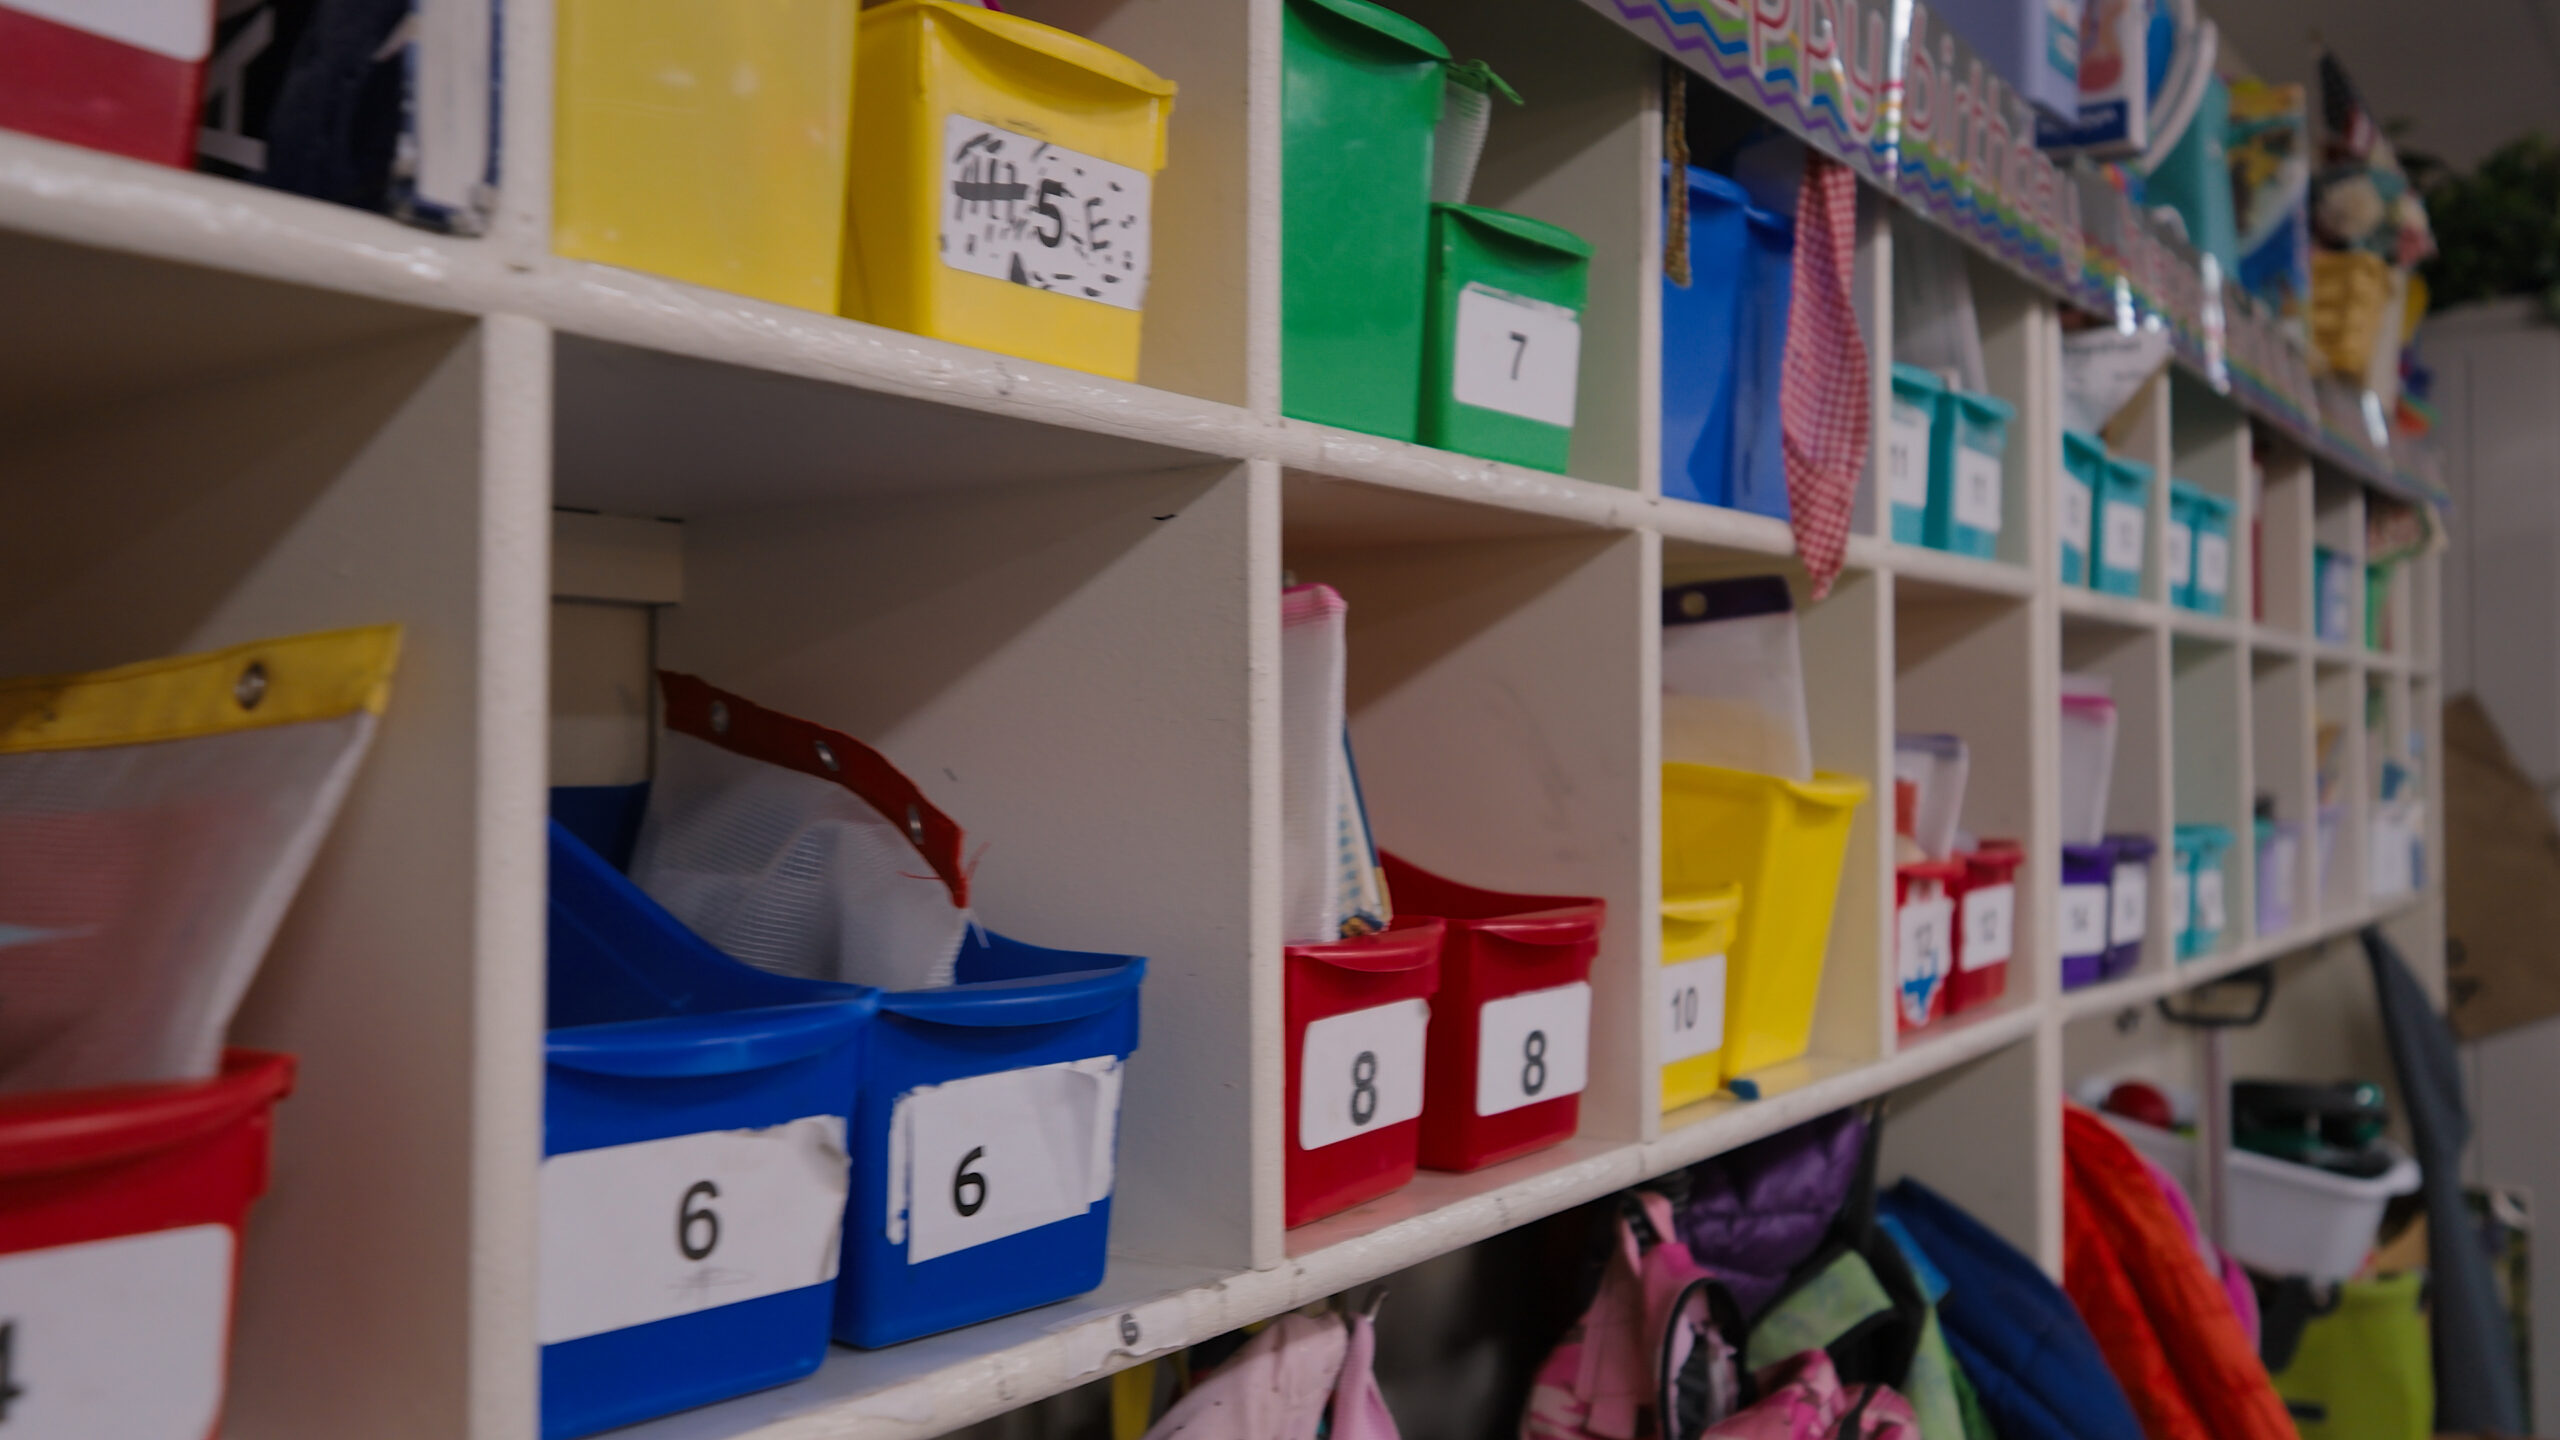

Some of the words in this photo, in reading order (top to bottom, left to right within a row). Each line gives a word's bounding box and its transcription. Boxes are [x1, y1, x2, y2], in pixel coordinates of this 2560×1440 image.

[1903, 4, 2082, 285] birthday
[1038, 178, 1066, 249] 5
[1510, 331, 1528, 381] 7
[1672, 985, 1699, 1033] 10
[1351, 1050, 1377, 1126] 8
[1522, 1029, 1546, 1096] 8
[950, 1145, 988, 1218] 6
[676, 1179, 723, 1262] 6
[1119, 1312, 1140, 1347] 6
